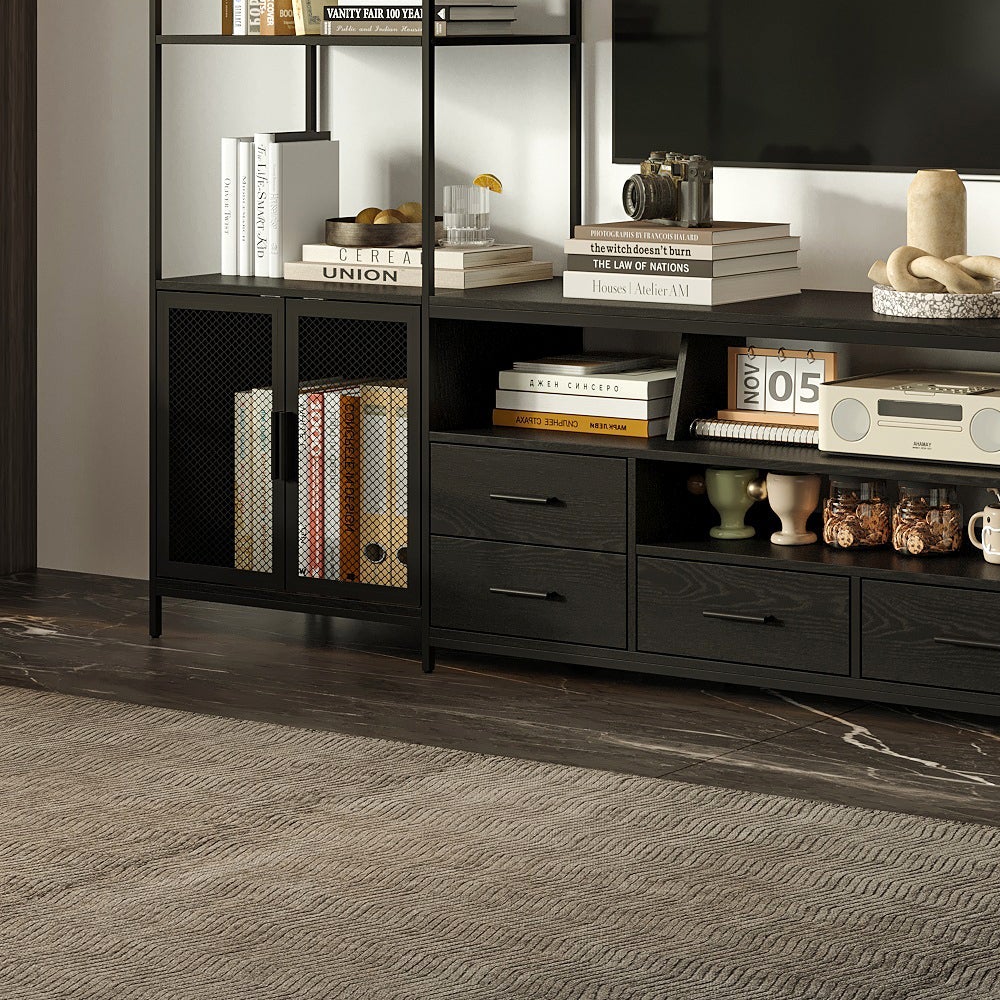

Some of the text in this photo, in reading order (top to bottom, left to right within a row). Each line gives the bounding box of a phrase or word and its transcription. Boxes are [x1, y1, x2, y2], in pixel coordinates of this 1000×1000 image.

[267, 2, 275, 26] COVER
[280, 9, 293, 18] BOO
[327, 8, 361, 19] VANITY
[363, 8, 383, 19] FAIR
[386, 8, 400, 19] 100
[590, 230, 635, 239] PHOTOGRAPHS
[643, 232, 673, 241] FRANÇOIS
[674, 233, 699, 241] HALARD
[591, 243, 691, 257] the witch doesn't burn
[593, 259, 690, 273] THE LAW OF NATIONS
[323, 267, 397, 282] UNION
[593, 279, 689, 297] Houses Atelier AM
[530, 380, 619, 392] ДЖЕН СИНСЕРО
[744, 363, 760, 404] NOV
[769, 371, 821, 403] 05
